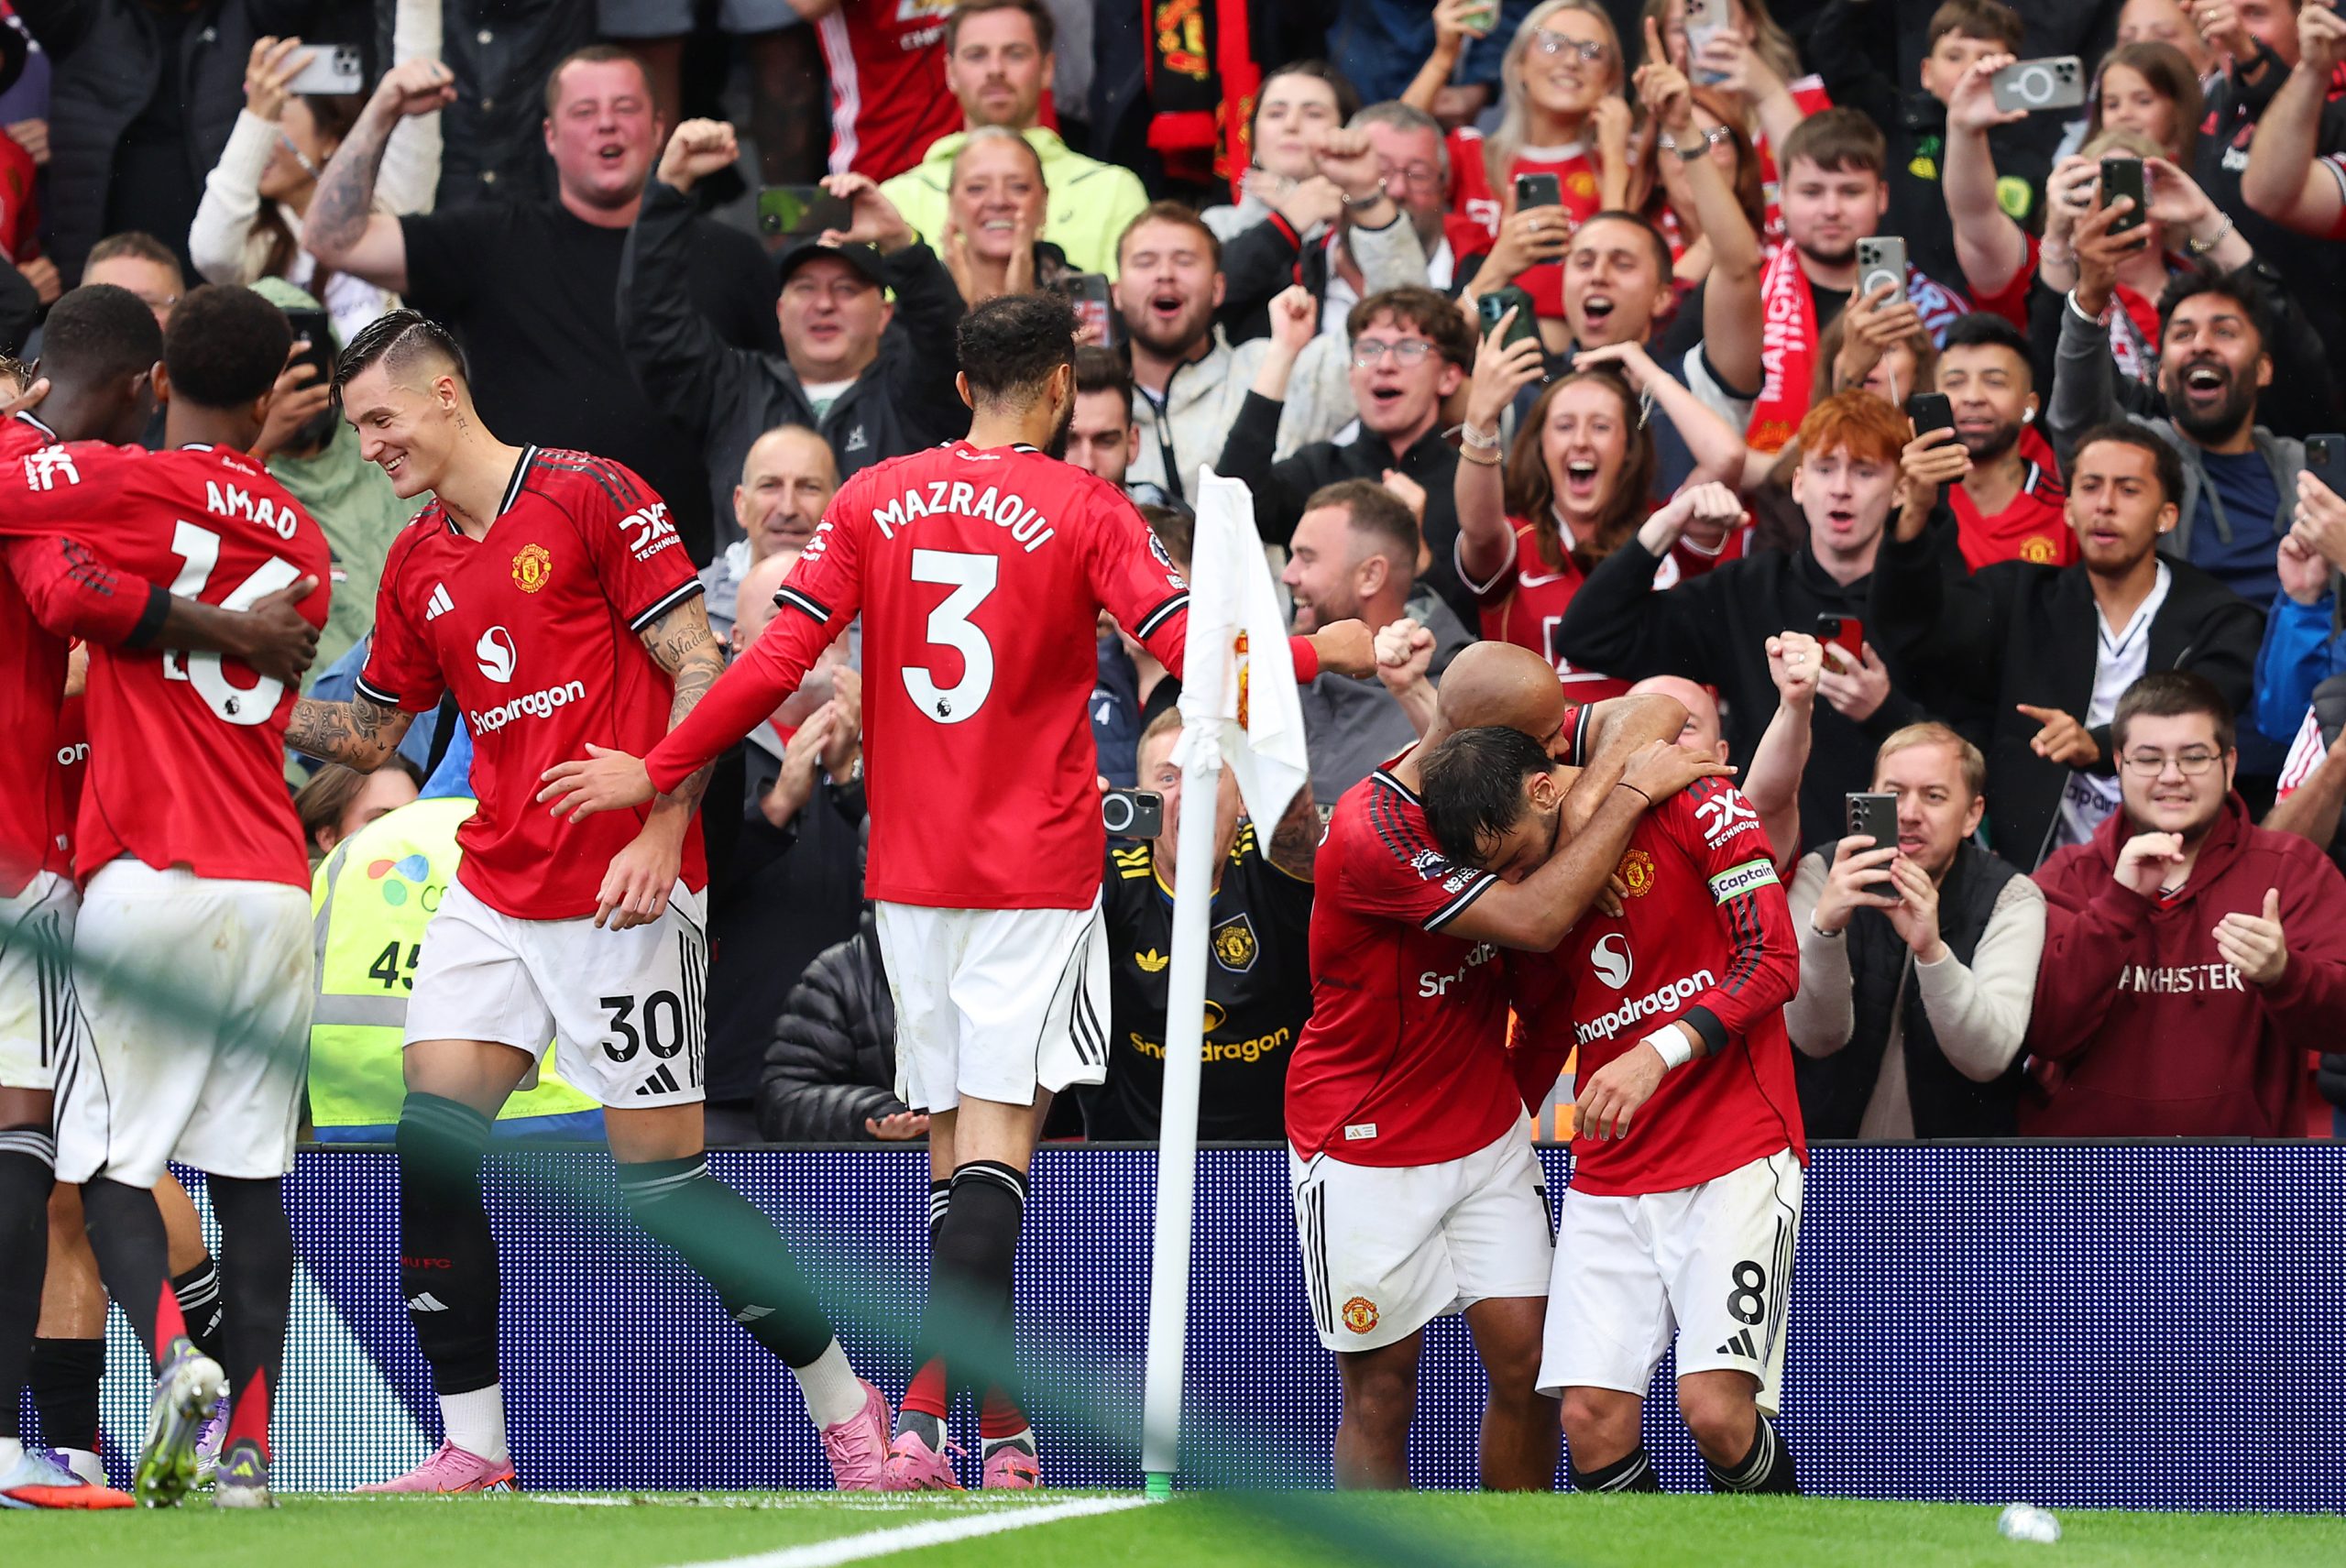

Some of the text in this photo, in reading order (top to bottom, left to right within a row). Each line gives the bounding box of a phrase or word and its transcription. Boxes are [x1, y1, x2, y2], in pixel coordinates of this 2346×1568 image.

[205, 480, 298, 541] AMAD
[872, 481, 1054, 554] MAZRAOUI
[901, 548, 999, 724] 3
[1718, 864, 1775, 893] Captain
[599, 990, 685, 1063] 30
[1129, 1026, 1290, 1063] Sndragon
[1727, 1260, 1766, 1325] 8
